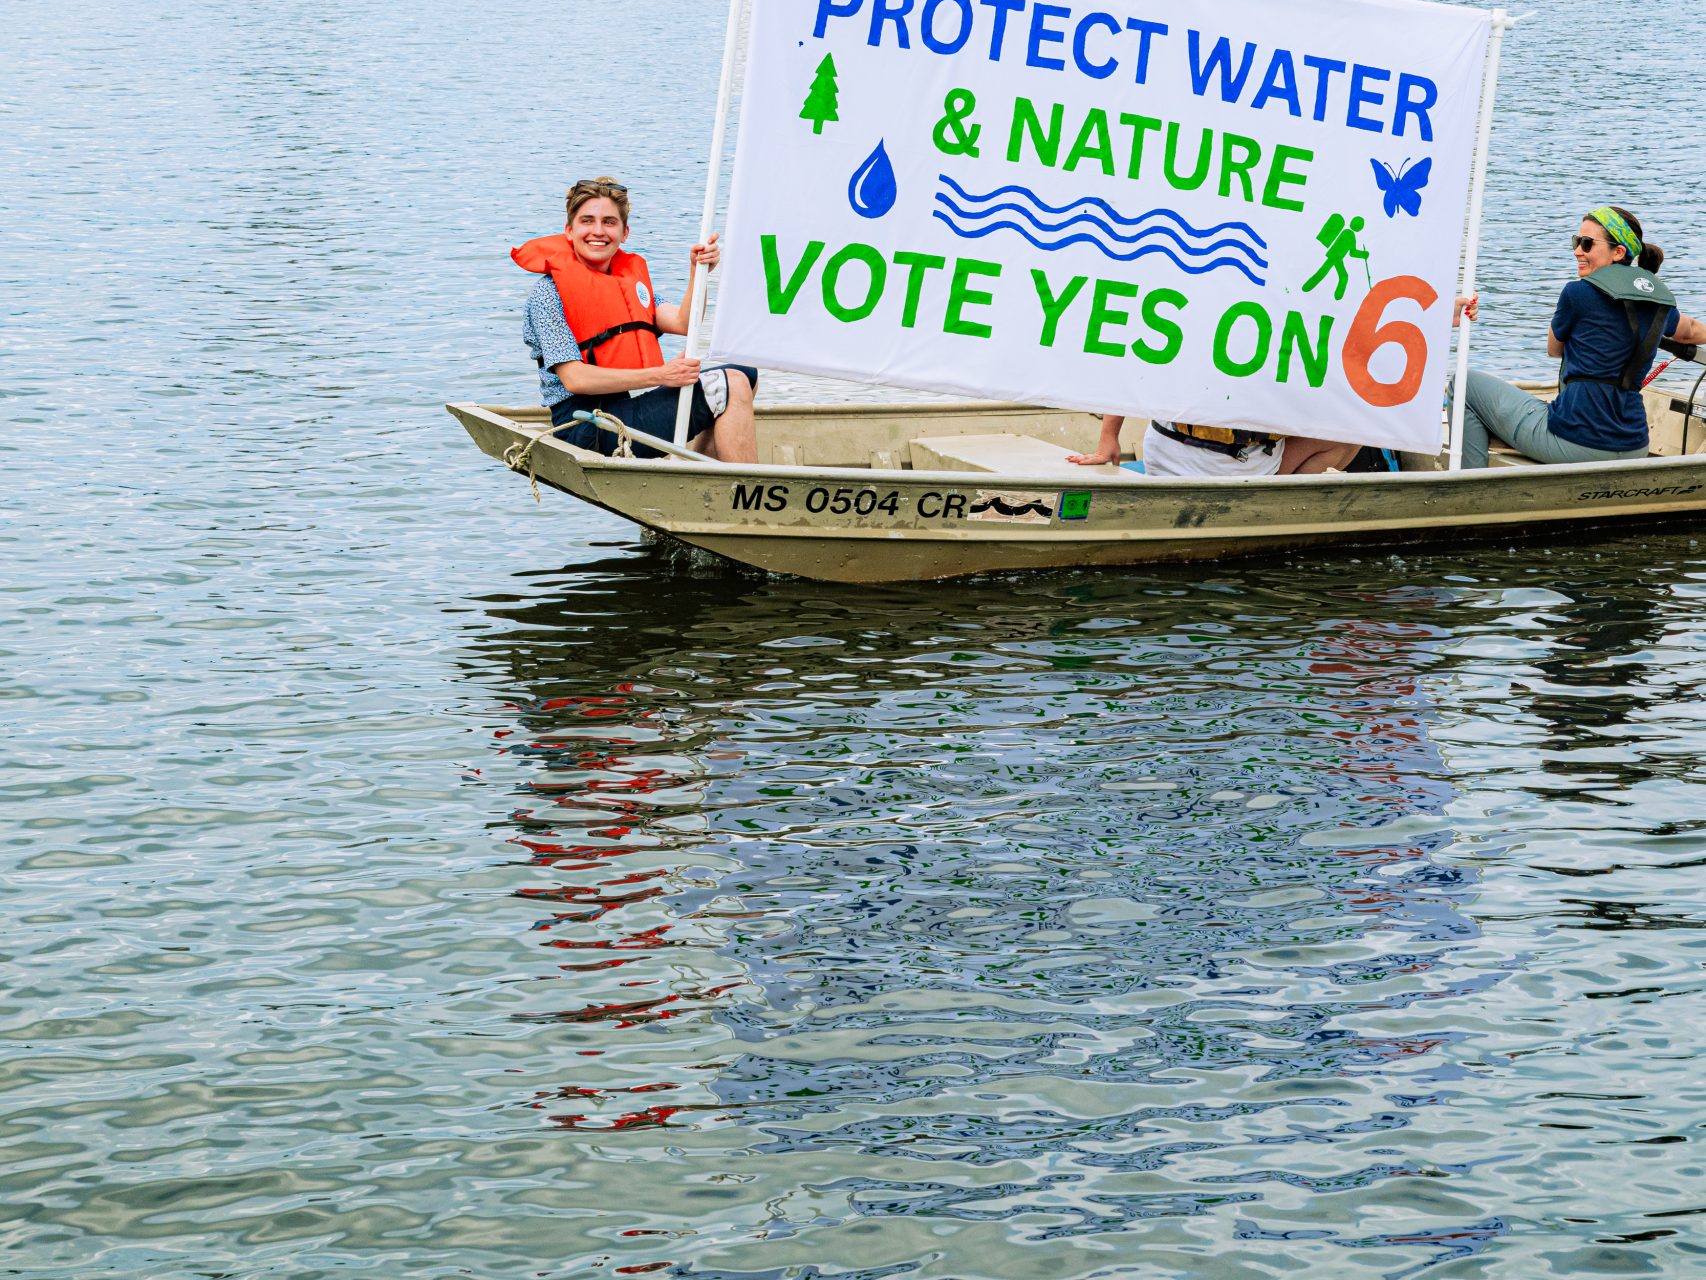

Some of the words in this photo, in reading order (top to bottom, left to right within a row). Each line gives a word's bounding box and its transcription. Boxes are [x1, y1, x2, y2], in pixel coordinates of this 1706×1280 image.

[1187, 29, 1438, 143] WATER
[932, 87, 981, 158] &
[1006, 96, 1314, 212] NATURE
[760, 234, 1002, 339] VOTE
[1030, 269, 1189, 365] YES
[1212, 301, 1335, 388] ON
[1341, 275, 1438, 407] 6
[732, 484, 789, 512] MS
[805, 487, 899, 516] 0504
[917, 491, 967, 519] CR
[1577, 486, 1682, 501] STARCRAFT
